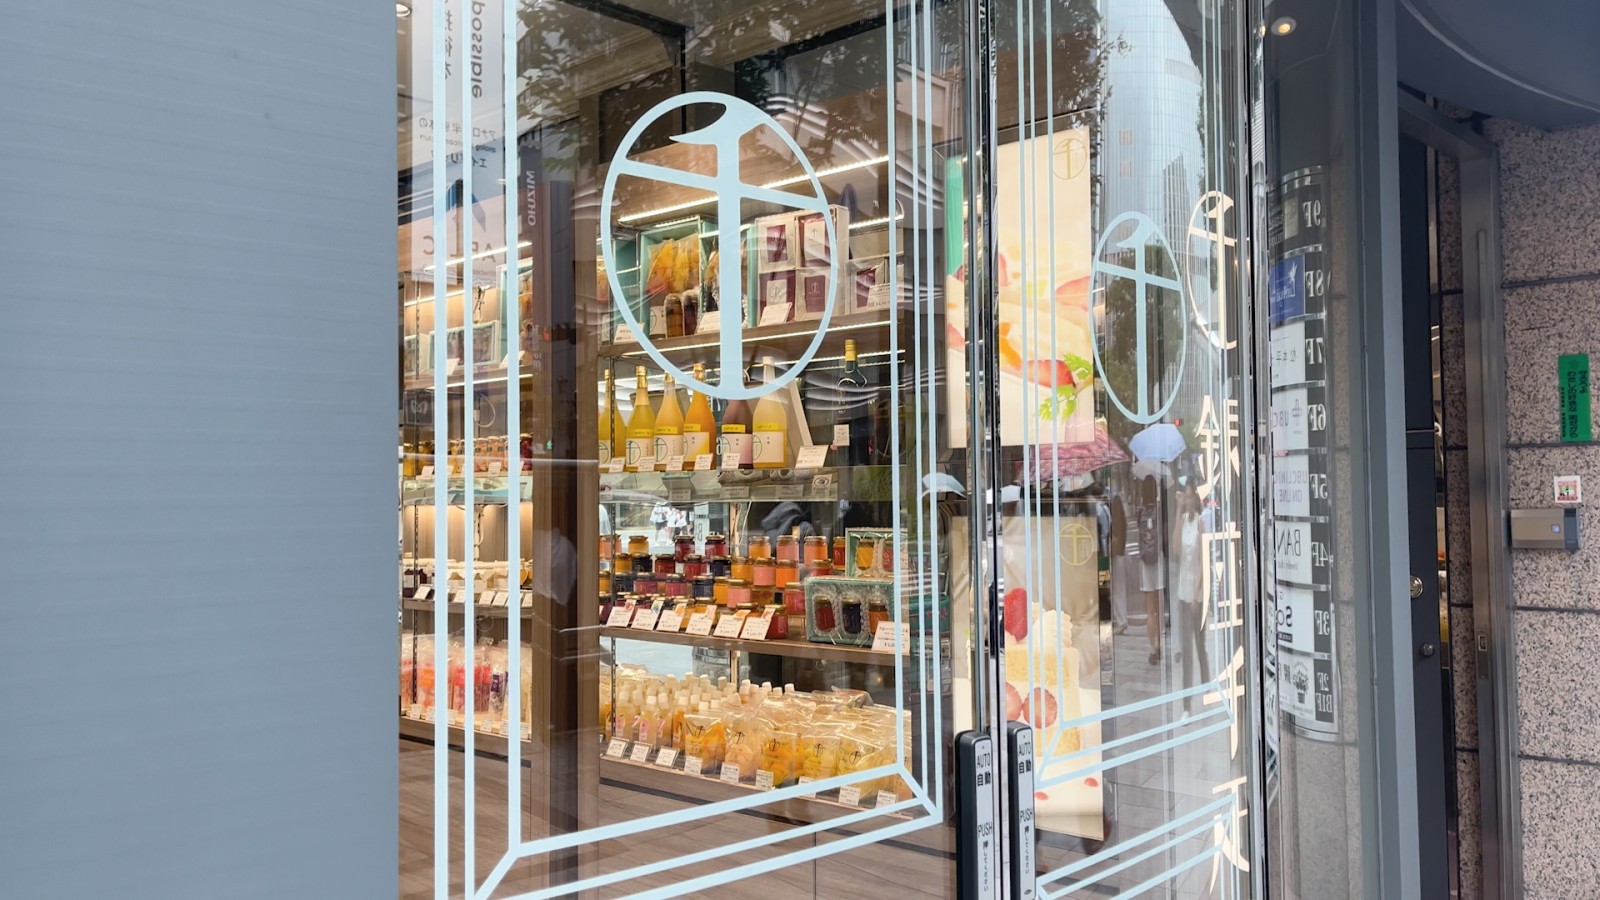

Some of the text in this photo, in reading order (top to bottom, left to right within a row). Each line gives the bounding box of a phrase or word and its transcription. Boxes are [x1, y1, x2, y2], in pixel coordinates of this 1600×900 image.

[1018, 741, 1031, 756] AUTO
[977, 753, 991, 768] AUTO
[1018, 759, 1032, 774] 自動
[977, 772, 991, 787] 自動
[1020, 807, 1033, 823] PUSH
[978, 822, 992, 838] PUSH
